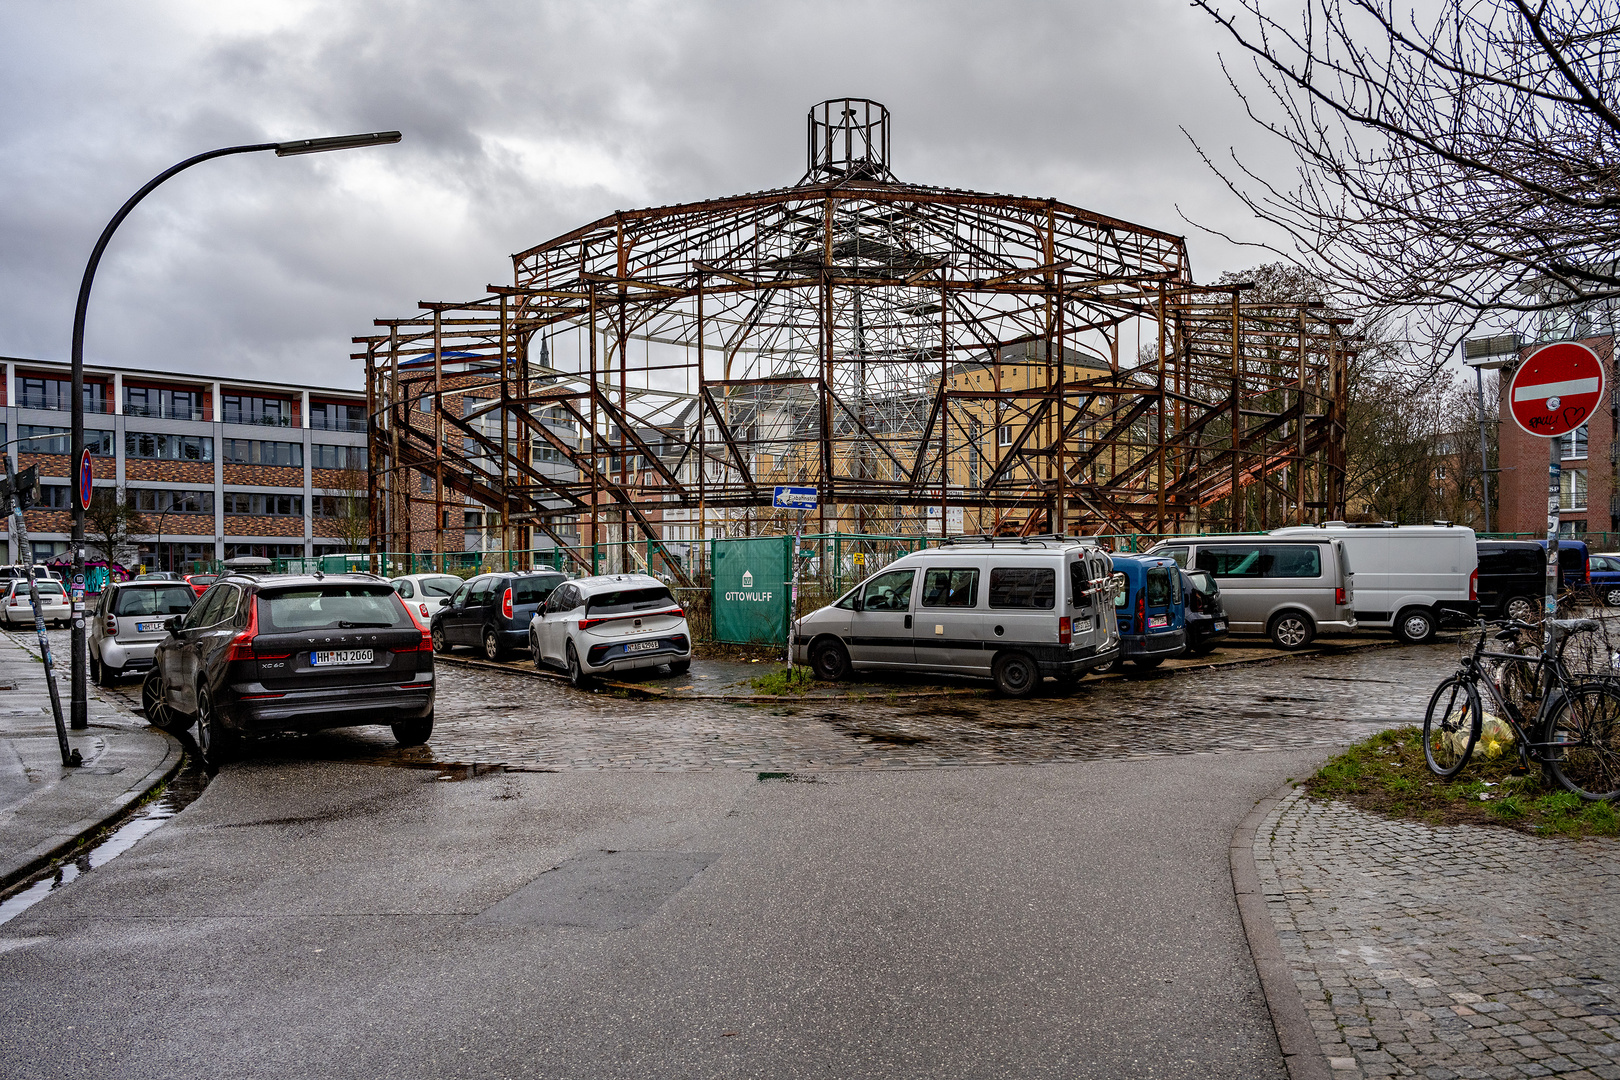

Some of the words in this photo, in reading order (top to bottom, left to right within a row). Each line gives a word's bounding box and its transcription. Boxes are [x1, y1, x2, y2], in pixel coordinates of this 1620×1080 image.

[725, 592, 745, 601] OTTO
[746, 592, 772, 602] WULFF
[317, 652, 330, 662] HH
[350, 650, 372, 660] 2060
